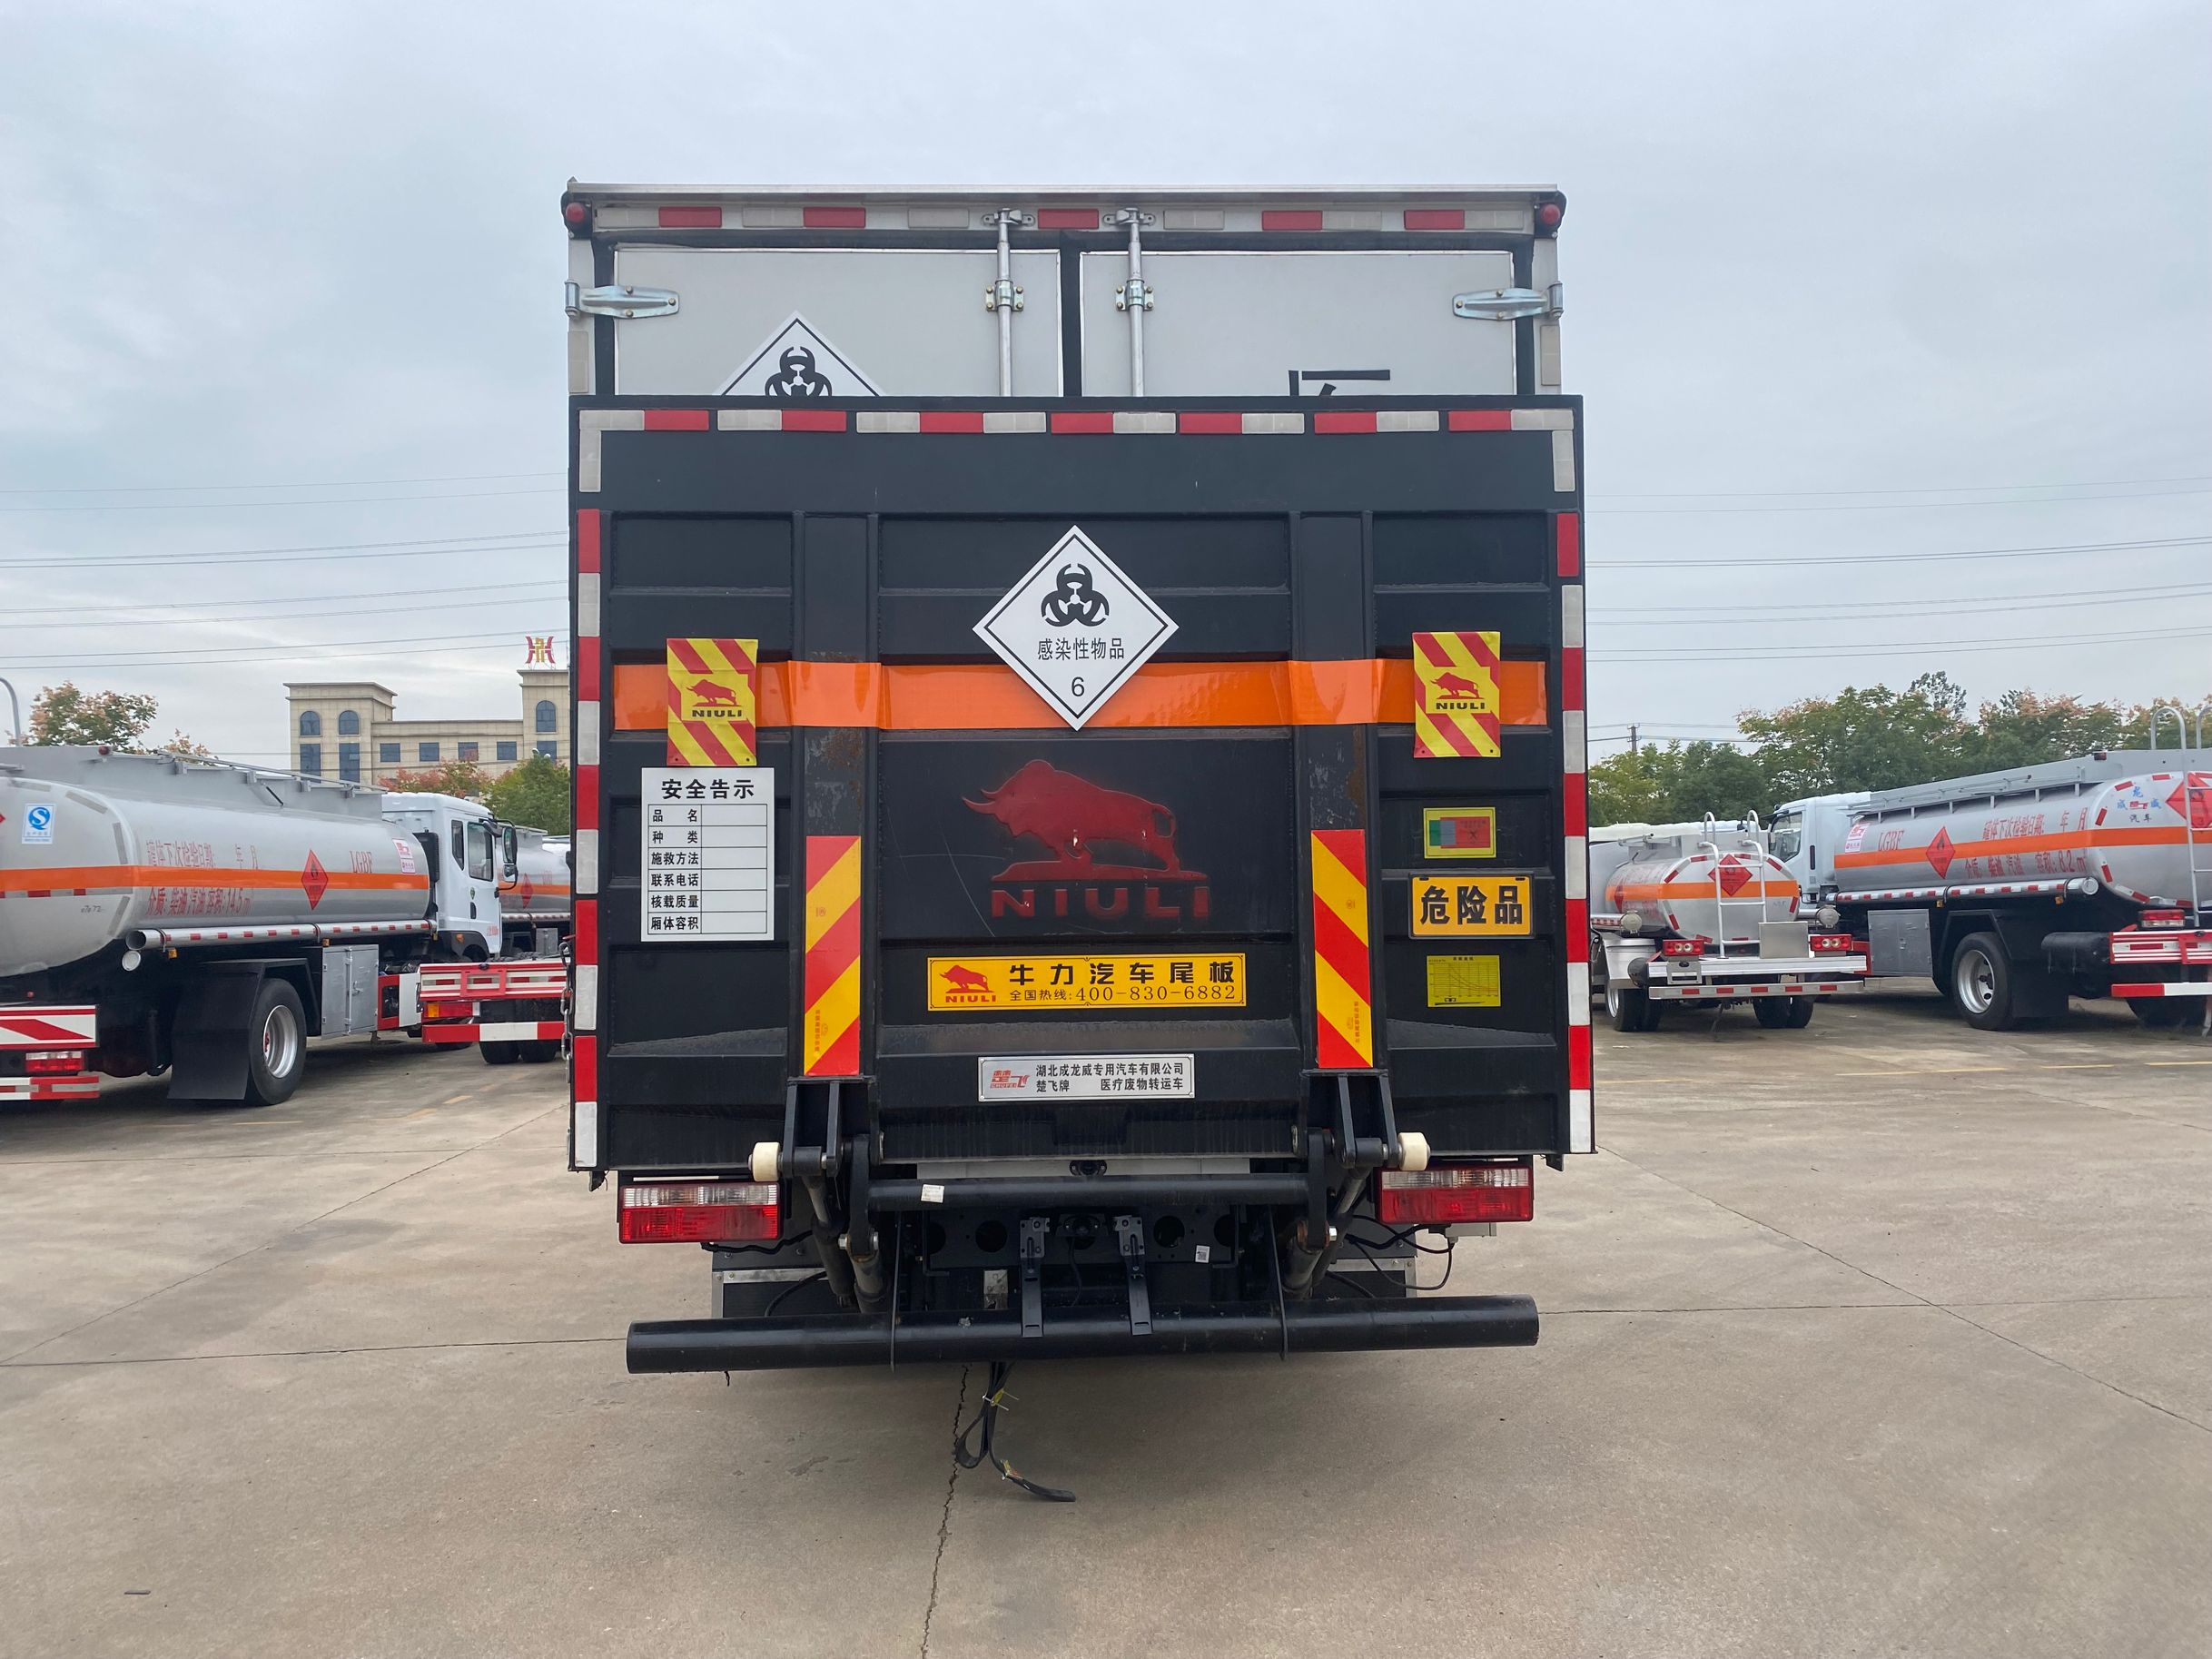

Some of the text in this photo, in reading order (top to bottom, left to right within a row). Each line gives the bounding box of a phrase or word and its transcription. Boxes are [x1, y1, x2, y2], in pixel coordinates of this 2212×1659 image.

[1037, 637, 1125, 661] 感染性物品
[1071, 676, 1085, 697] 6
[691, 709, 743, 718] NIULI
[1436, 702, 1486, 710] NIULI
[661, 778, 755, 800] 安全告示
[651, 852, 699, 865] 施救方法
[651, 874, 699, 887] 联系电话
[651, 895, 699, 909] 核载质量
[991, 886, 1211, 919] NIULI
[1420, 884, 1523, 925] 危险品
[651, 916, 699, 931] 厢体容积
[1009, 961, 1235, 986] 牛力汽车尾板
[1036, 1062, 1184, 1078] 湖北成龙威专用汽车有限公司
[1036, 1077, 1183, 1092] 楚飞牌 医疗废物转运车
